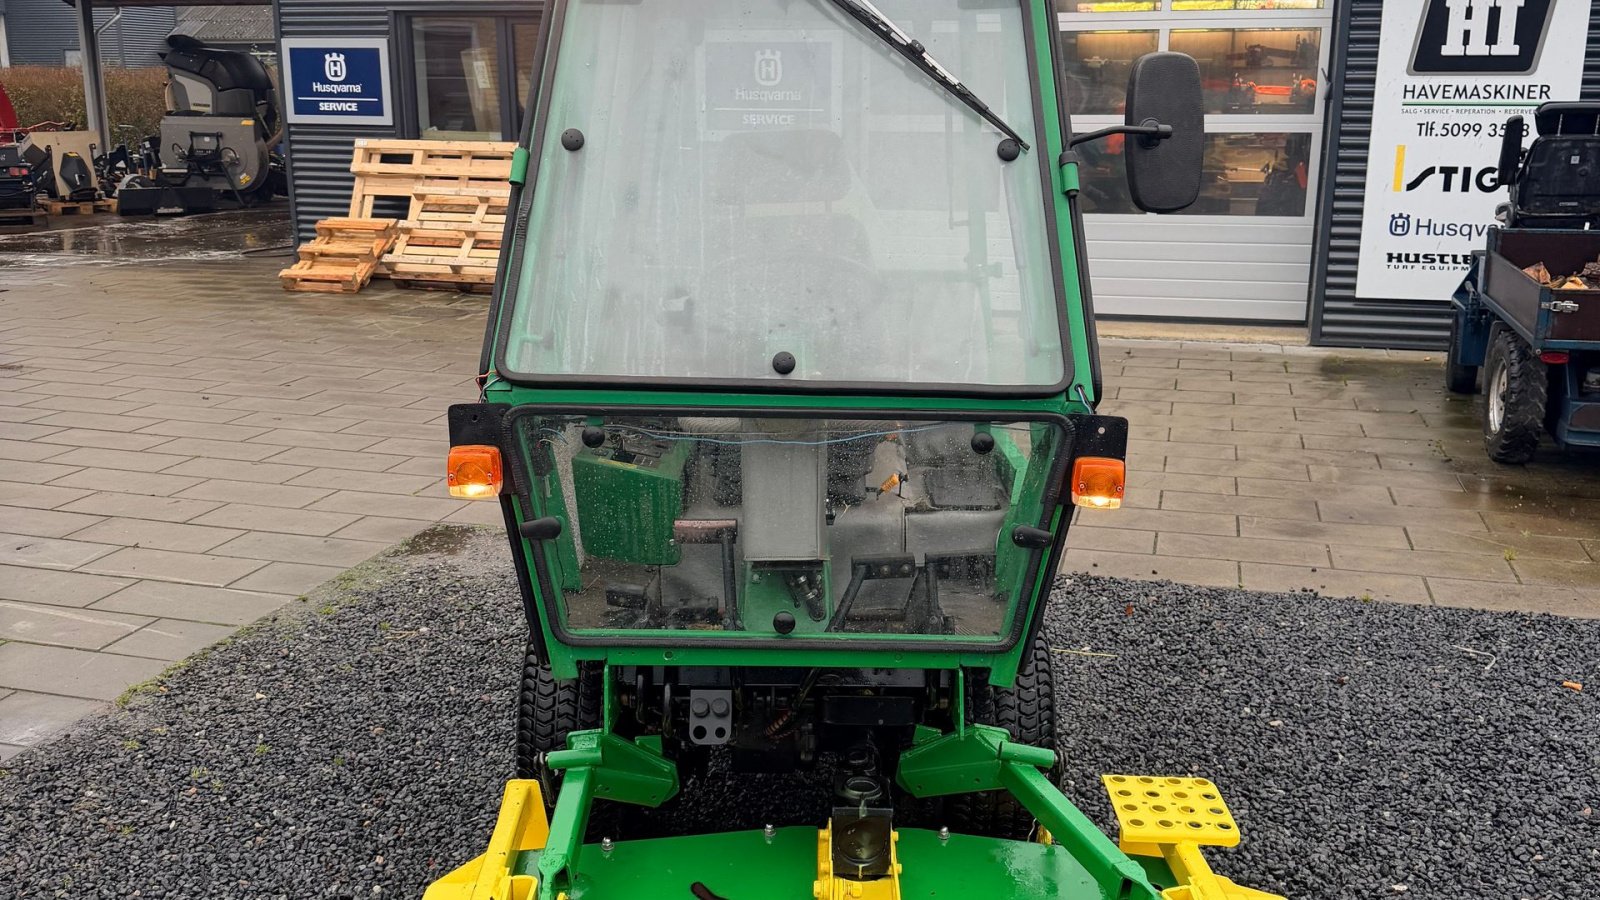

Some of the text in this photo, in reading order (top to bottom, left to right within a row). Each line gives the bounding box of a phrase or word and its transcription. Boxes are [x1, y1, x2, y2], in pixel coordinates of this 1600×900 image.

[1440, 0, 1524, 56] HI
[312, 82, 362, 94] Husqvarna
[735, 87, 801, 103] Husqvarna
[1403, 84, 1551, 100] HAVEMASKINER
[319, 102, 358, 111] SERVICE
[742, 113, 796, 125] SERVICE
[1416, 121, 1530, 138] Tlf.5099 358
[1405, 166, 1510, 193] STIG
[1386, 252, 1471, 265] HUSTLE
